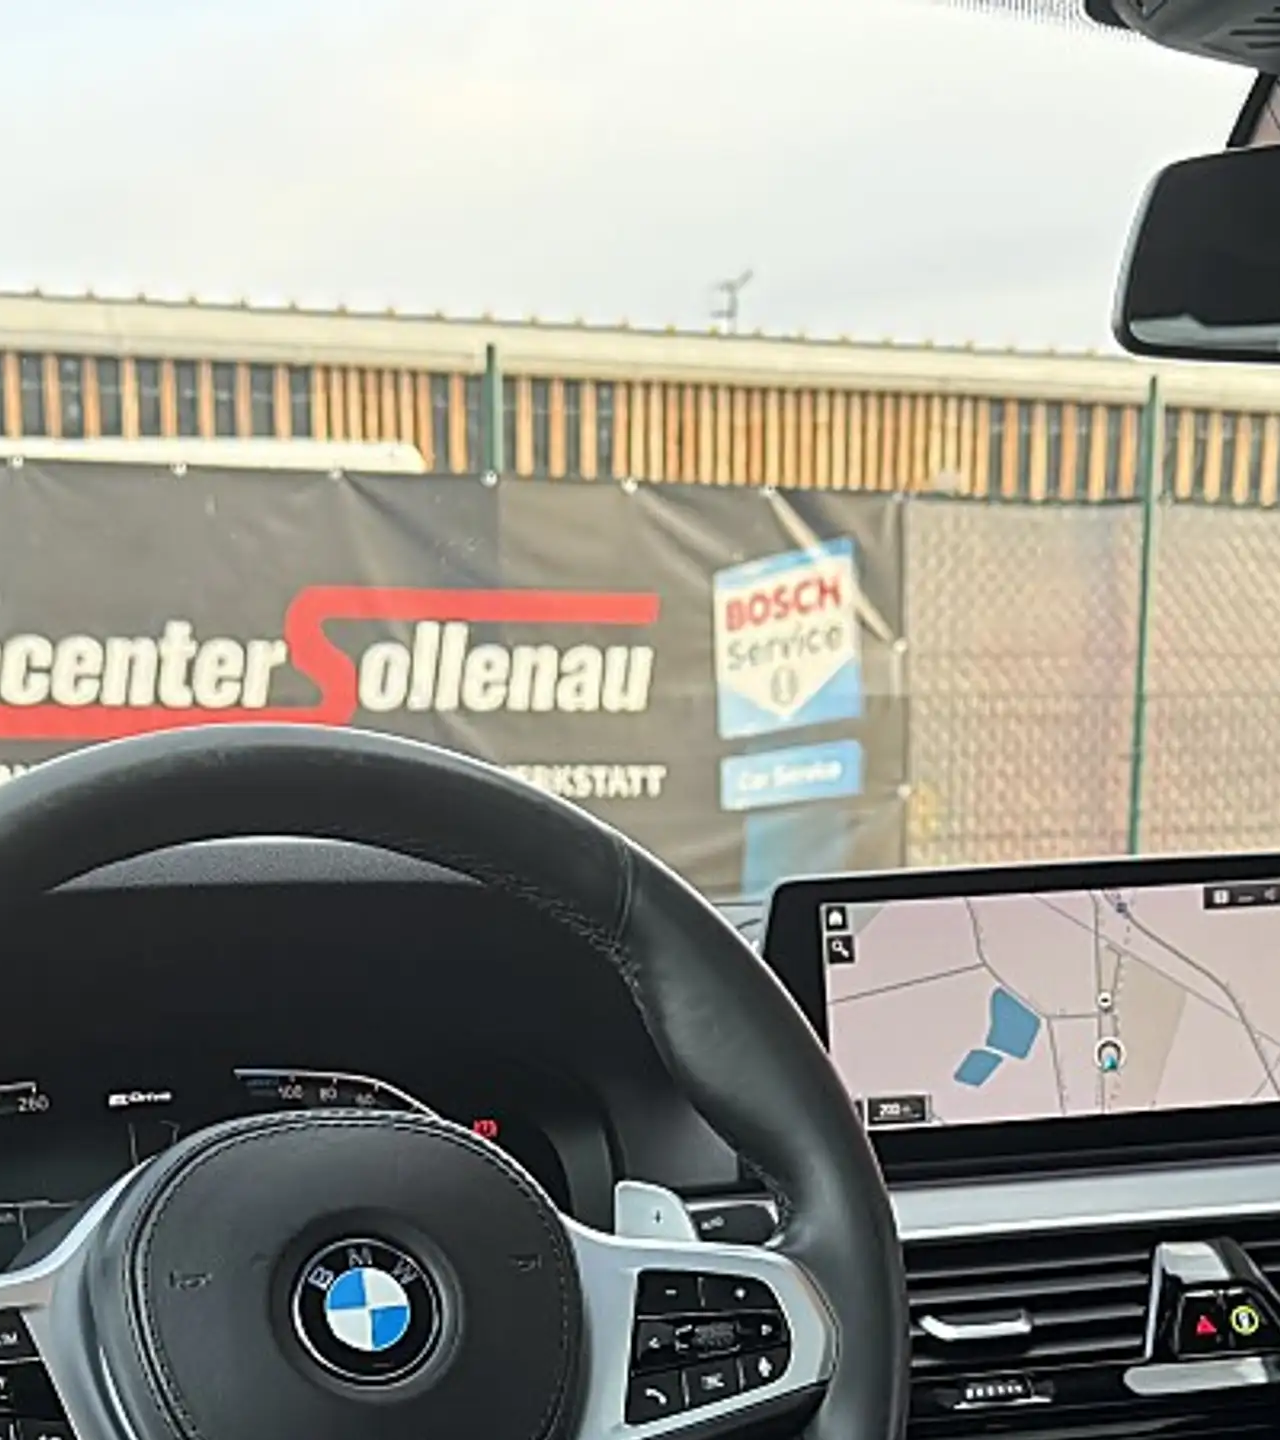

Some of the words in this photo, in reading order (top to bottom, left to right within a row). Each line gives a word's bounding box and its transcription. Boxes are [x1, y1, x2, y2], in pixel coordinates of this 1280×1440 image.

[725, 573, 842, 631] BOSCH
[284, 585, 660, 725] Sollenau
[727, 622, 842, 672] Service
[17, 1095, 50, 1113] 260
[307, 1247, 420, 1291] BMW
